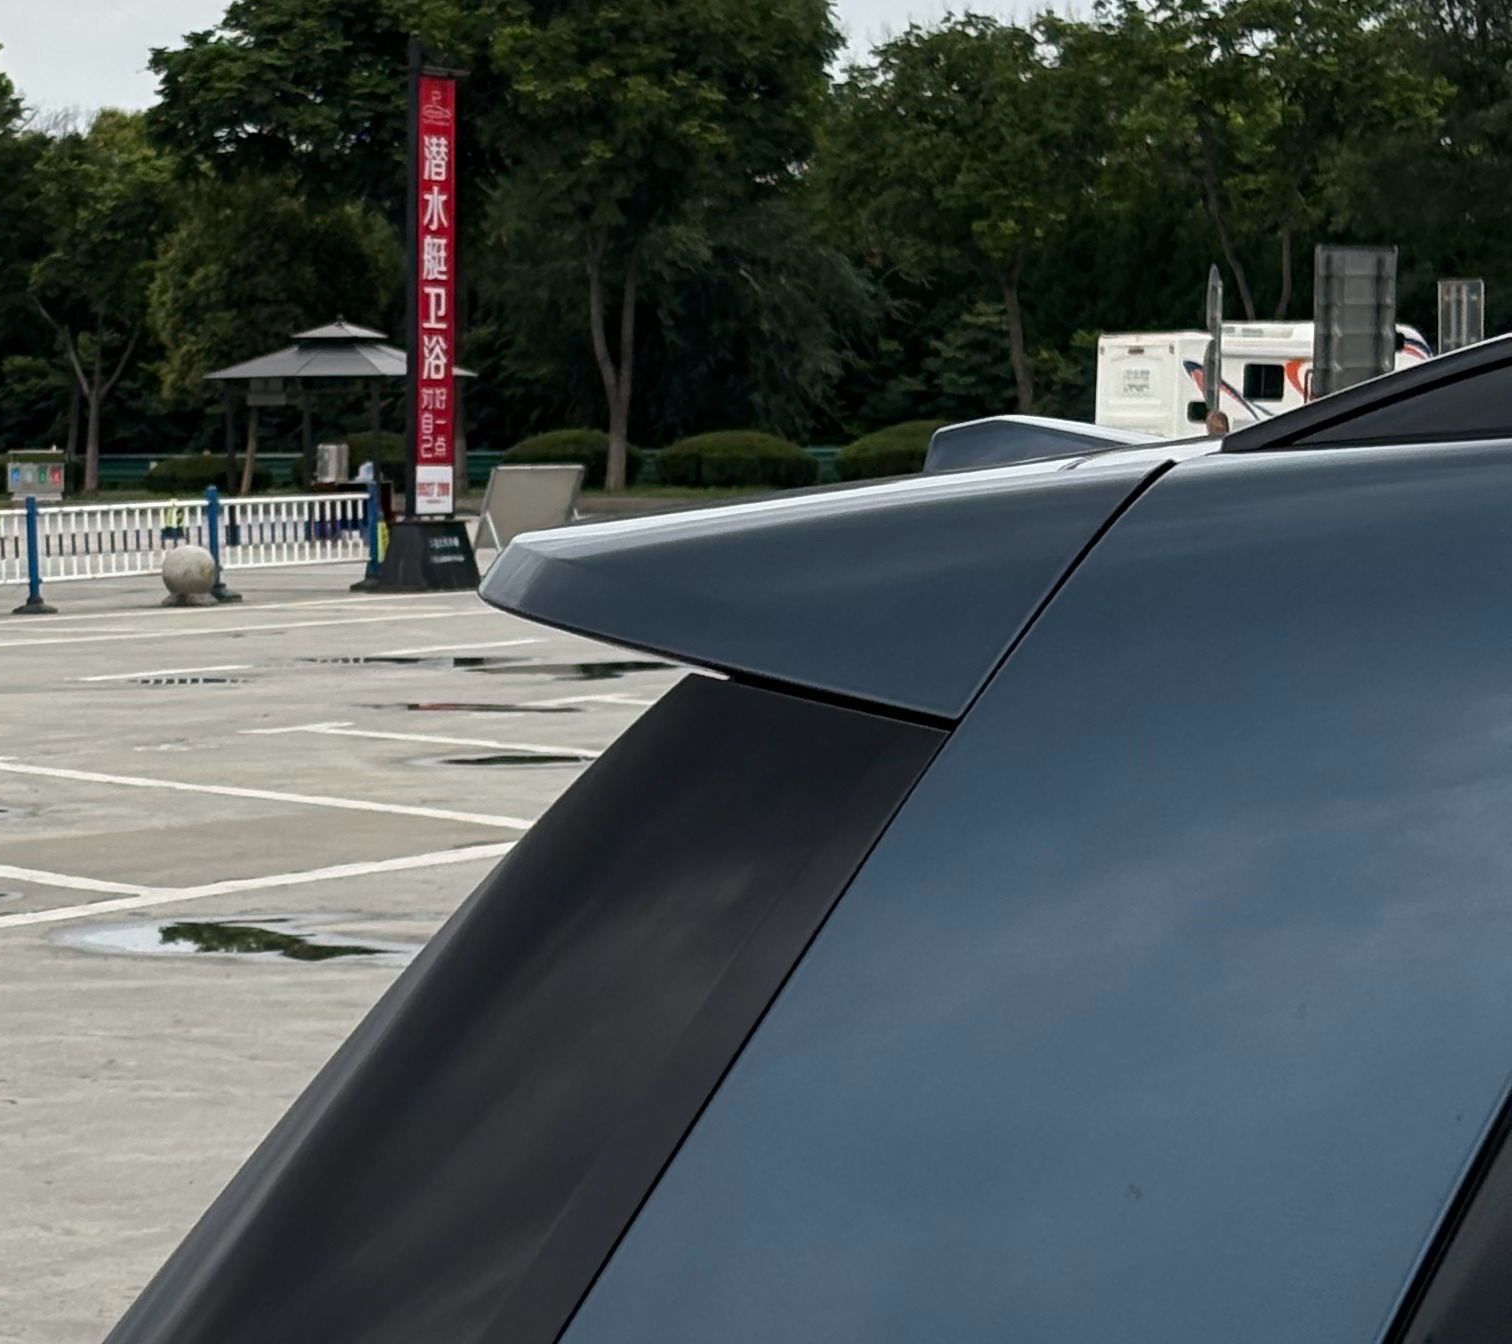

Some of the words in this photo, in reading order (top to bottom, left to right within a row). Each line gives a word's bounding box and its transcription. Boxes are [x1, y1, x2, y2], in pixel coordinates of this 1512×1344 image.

[422, 135, 449, 380] 潜水艇卫浴
